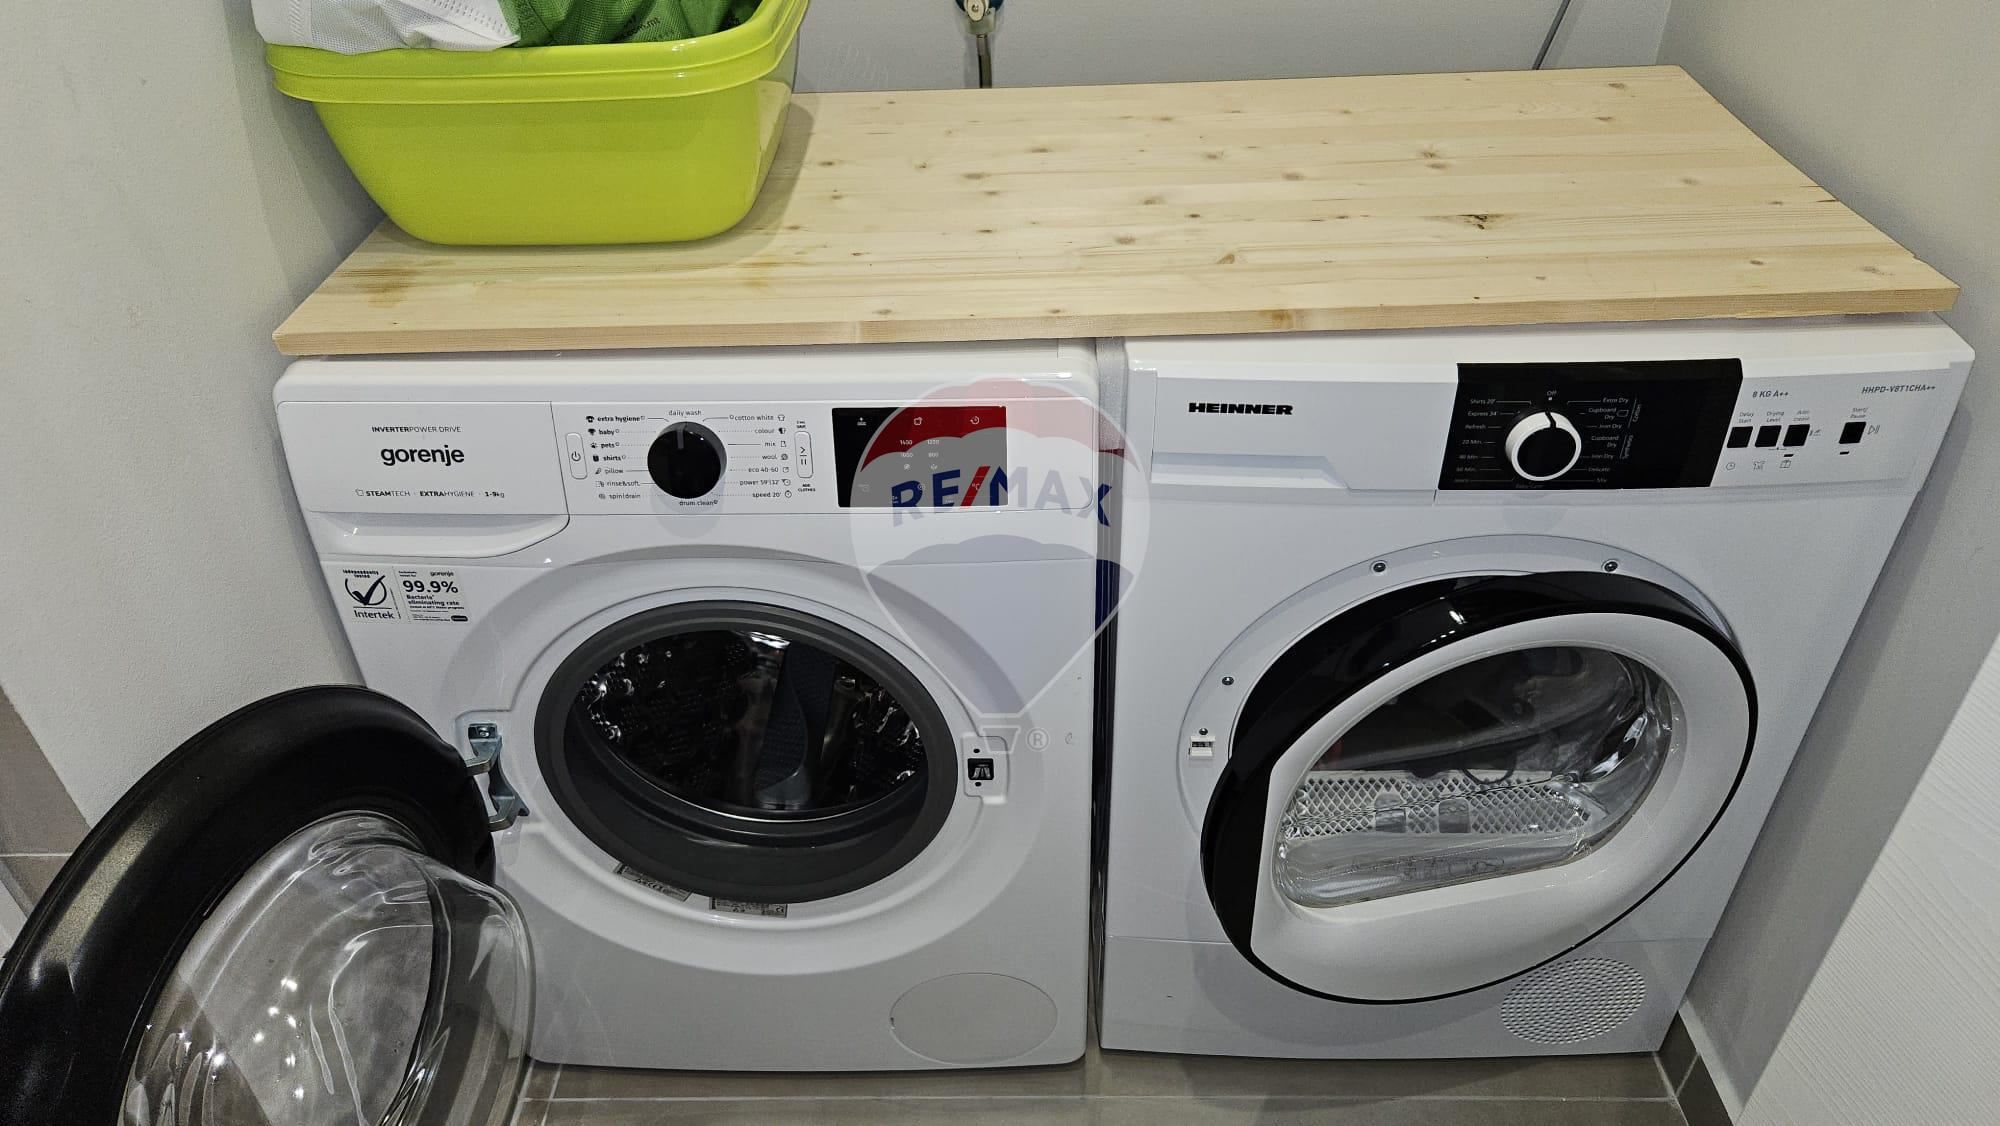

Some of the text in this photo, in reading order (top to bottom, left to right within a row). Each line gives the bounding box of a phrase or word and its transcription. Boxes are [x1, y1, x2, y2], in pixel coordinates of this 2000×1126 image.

[1188, 402, 1293, 415] HEINNER
[615, 415, 641, 424] hygiene
[380, 444, 465, 467] gorenje
[419, 490, 475, 498] EXTRAHYGIENE
[402, 580, 459, 593] 99.9%
[353, 610, 395, 619] Intertek
